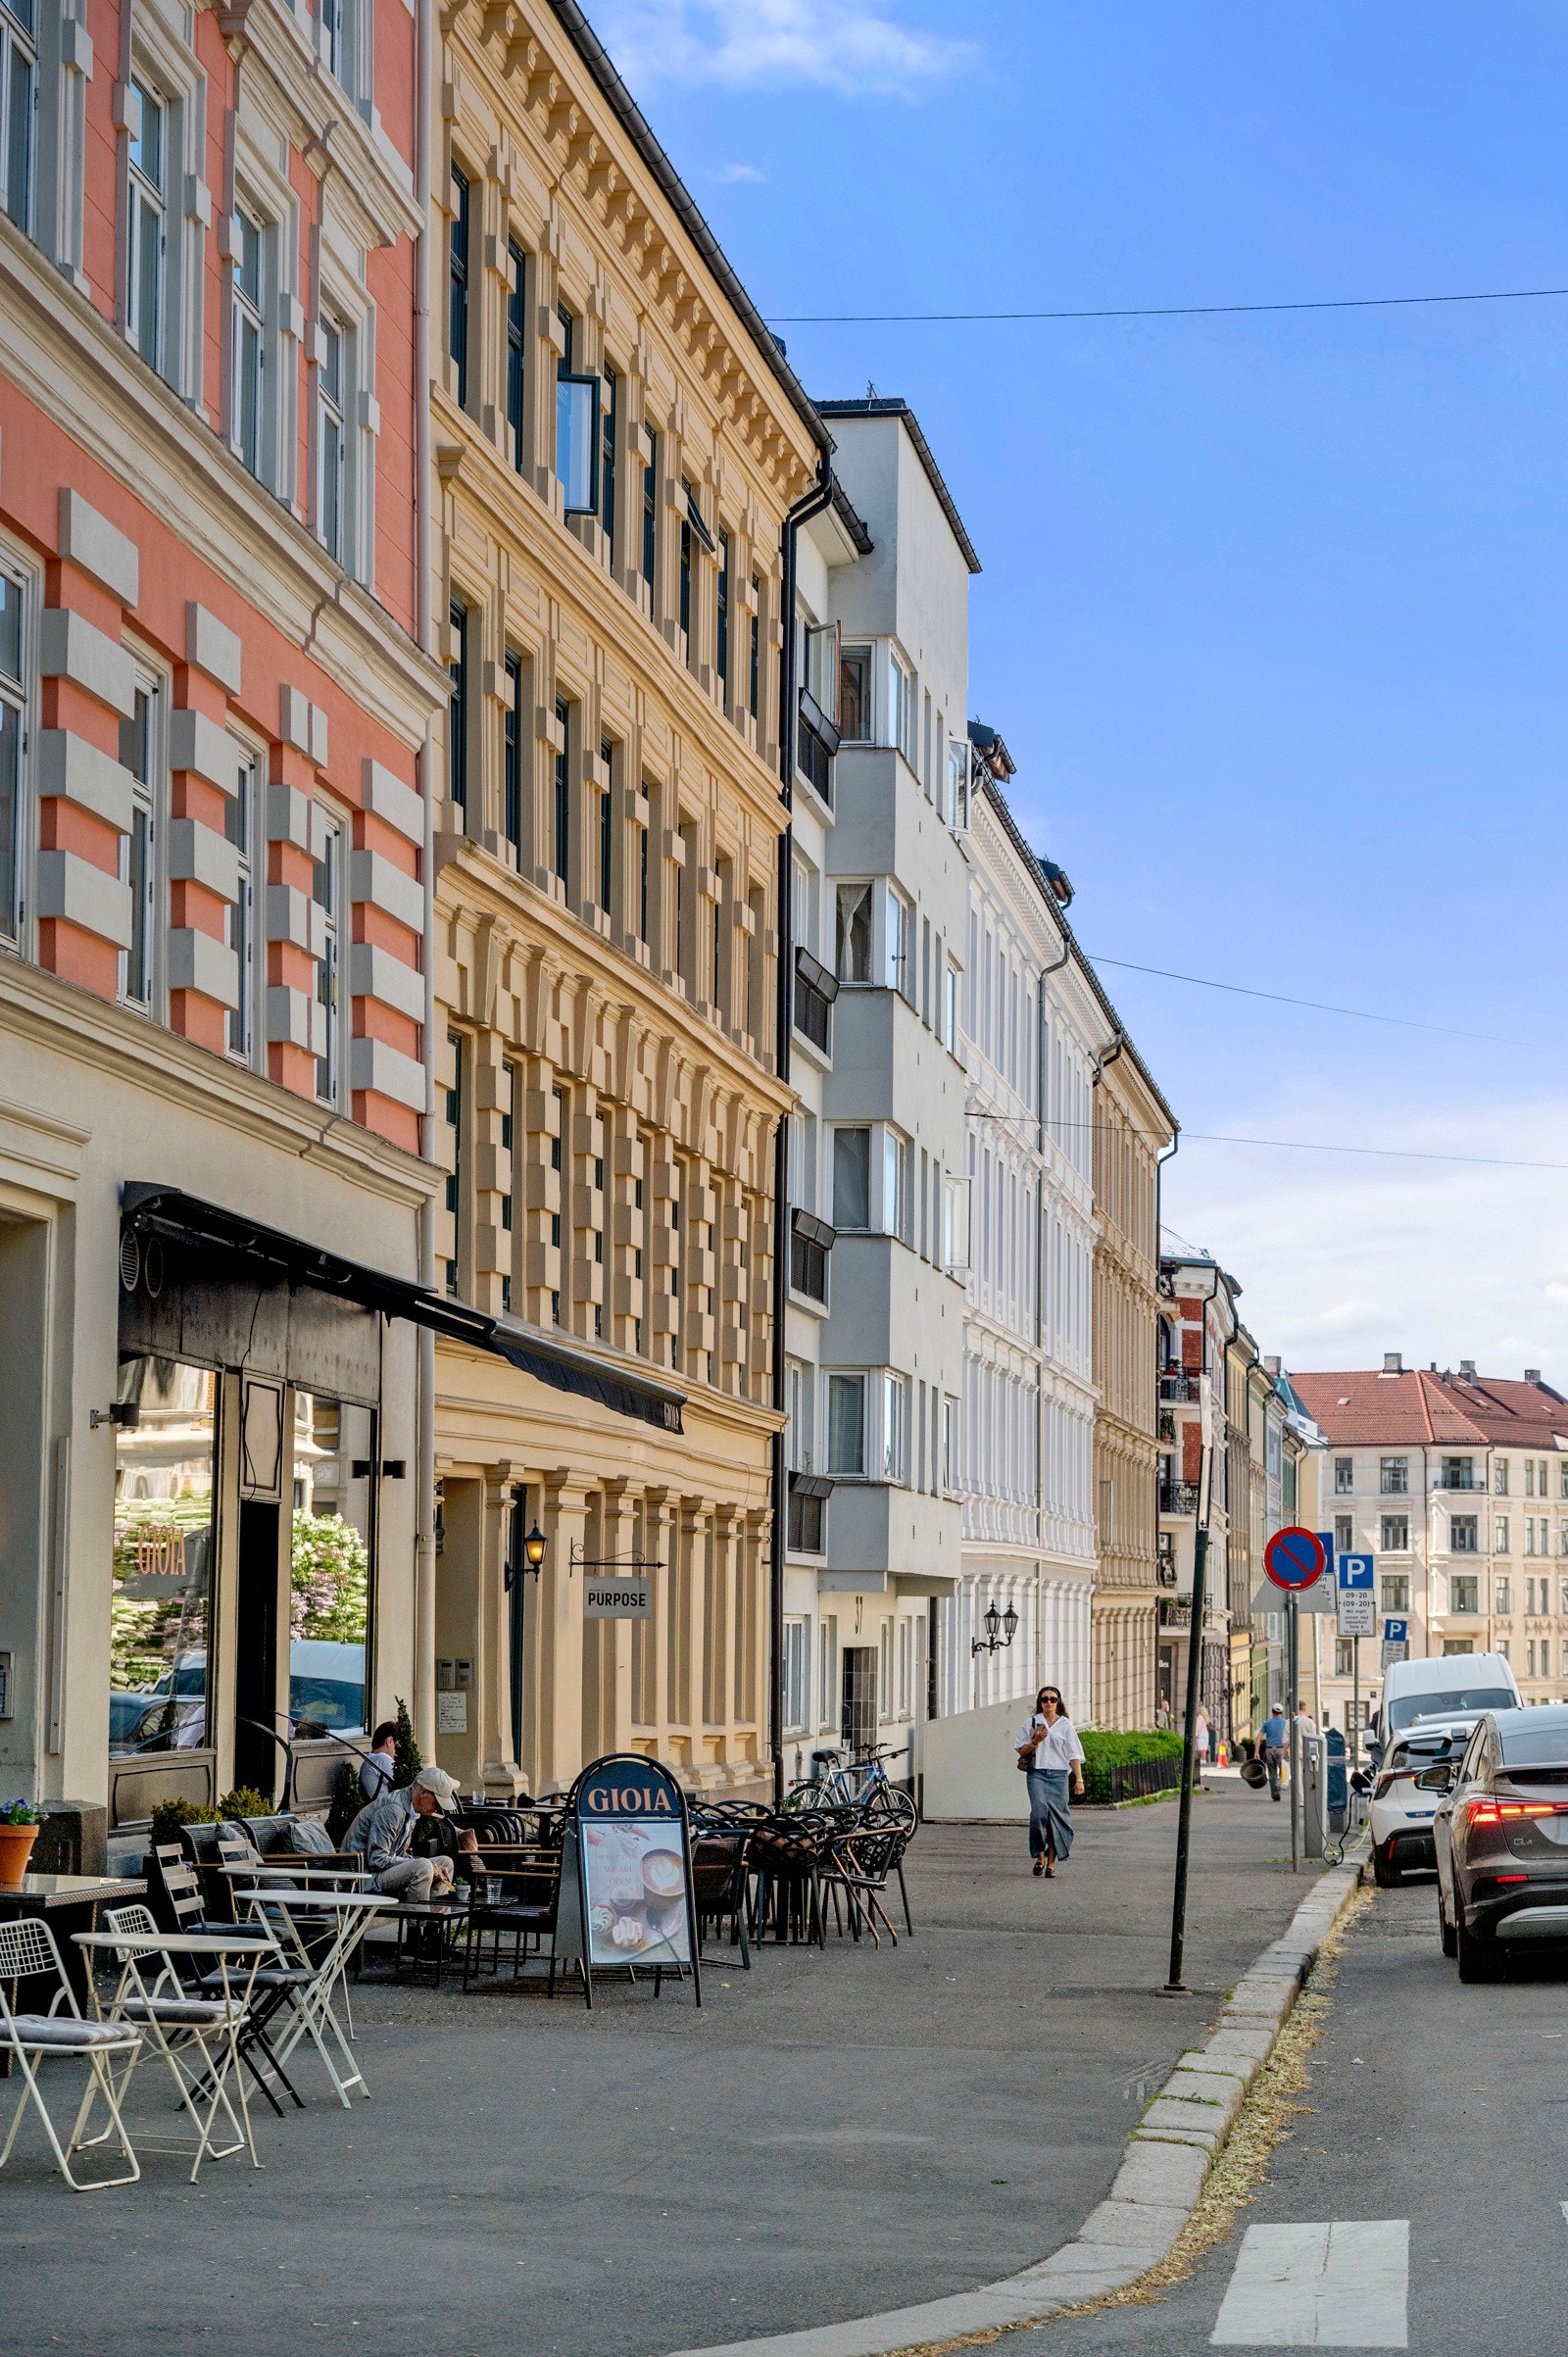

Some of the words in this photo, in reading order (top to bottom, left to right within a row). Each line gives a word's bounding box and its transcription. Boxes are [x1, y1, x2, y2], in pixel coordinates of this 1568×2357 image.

[138, 1525, 186, 1575] GIOIA
[1348, 1558, 1365, 1585] P
[588, 1592, 646, 1606] PURPOSE
[1390, 1622, 1402, 1639] P
[588, 1788, 672, 1812] GIOIA
